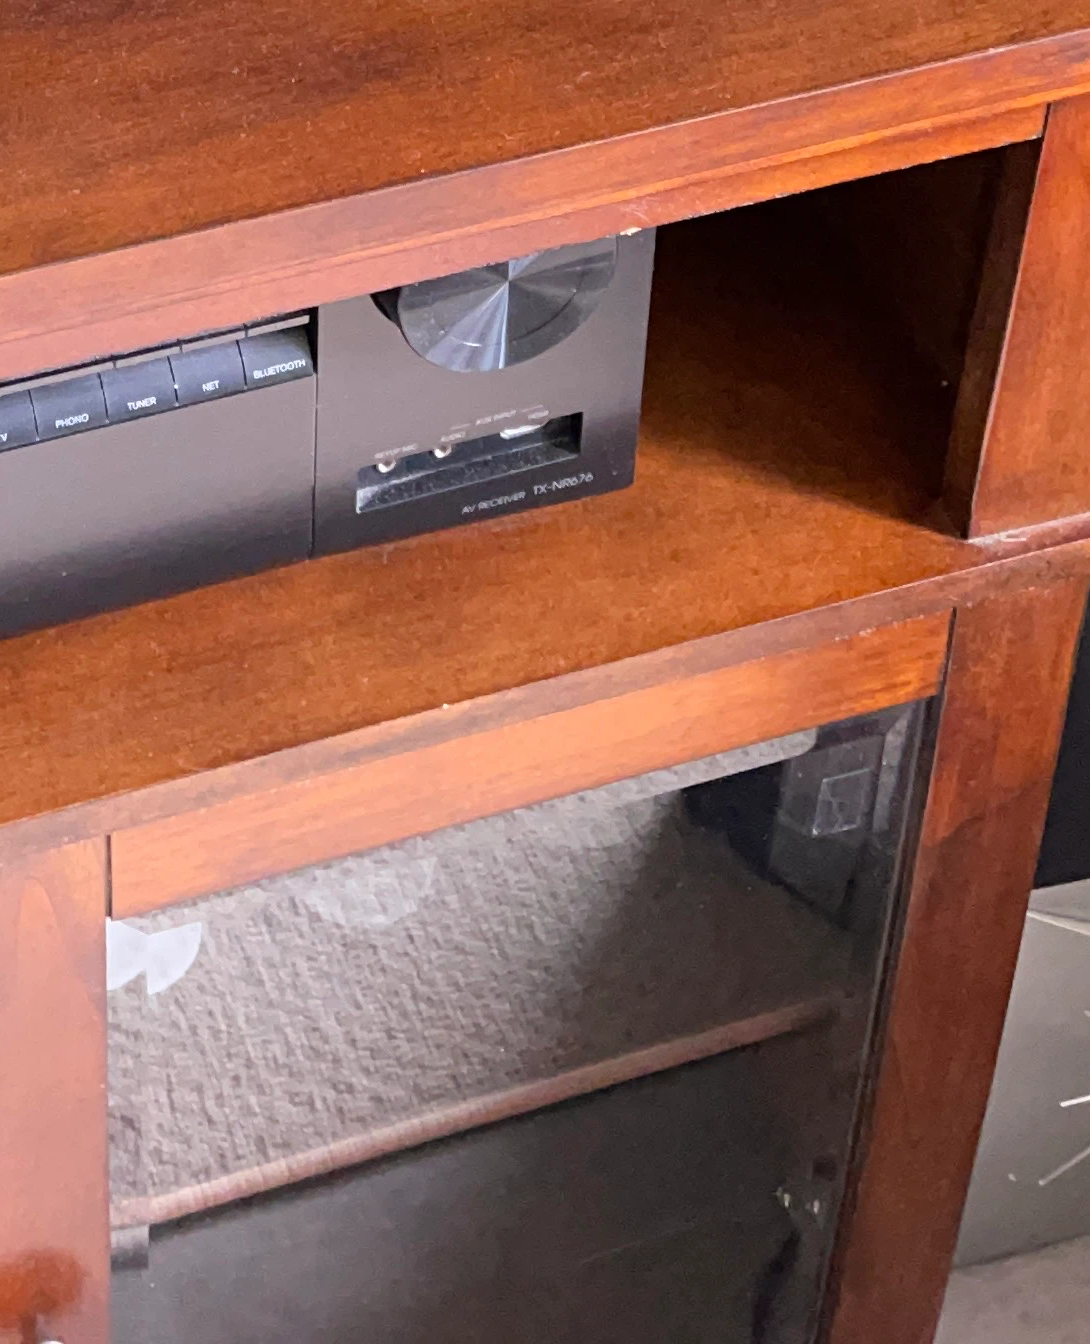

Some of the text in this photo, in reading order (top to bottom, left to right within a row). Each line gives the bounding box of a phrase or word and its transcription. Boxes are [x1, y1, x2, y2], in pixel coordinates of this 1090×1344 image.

[253, 358, 306, 379] BLUETOOTH
[202, 379, 220, 393] NET
[127, 396, 157, 412] TUNER
[55, 413, 89, 429] PHONO
